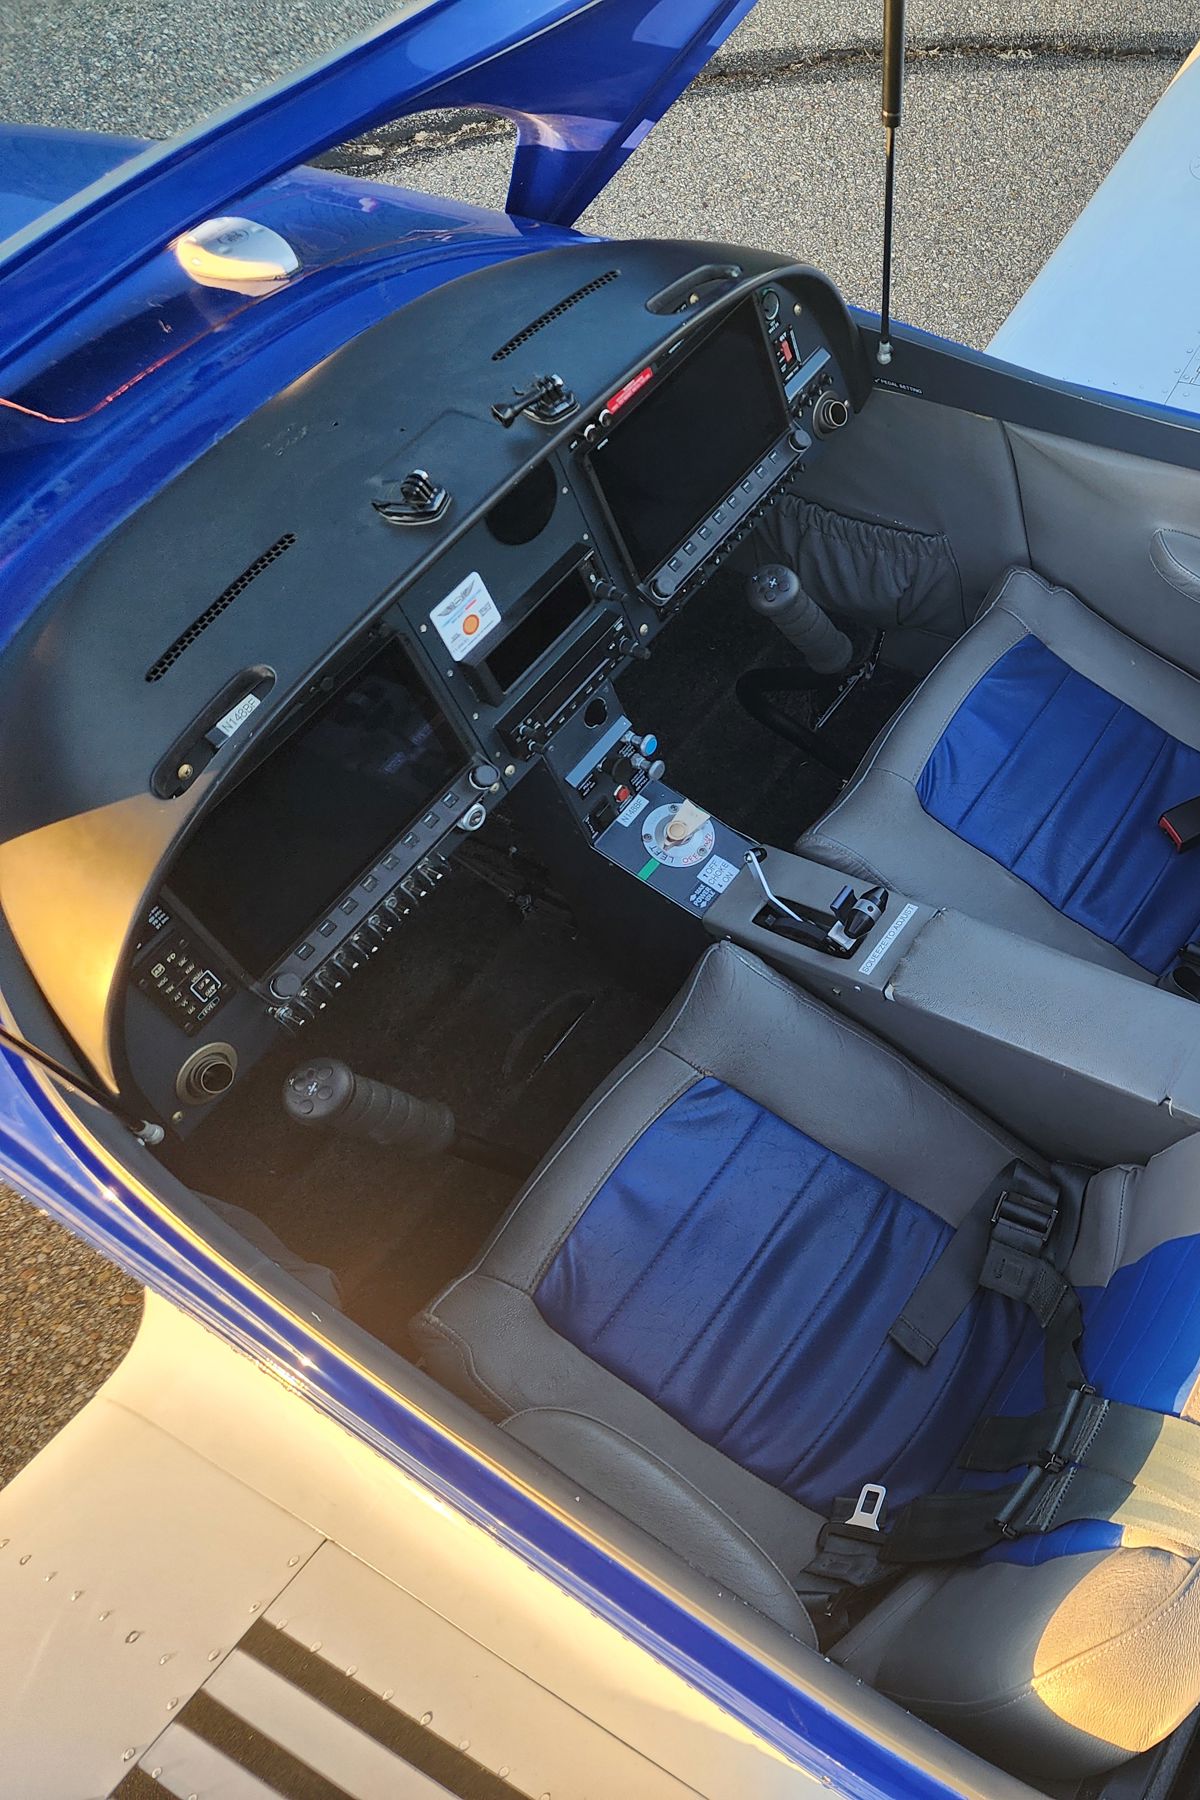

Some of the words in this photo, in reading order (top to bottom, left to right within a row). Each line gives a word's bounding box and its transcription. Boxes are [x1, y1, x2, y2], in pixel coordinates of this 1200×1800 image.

[880, 378, 899, 388] PEDAL
[222, 698, 257, 733] N148BF
[649, 845, 675, 864] LEFT
[705, 860, 718, 874] OFF
[707, 862, 729, 886] CHOKE
[723, 871, 734, 883] ON
[693, 886, 712, 907] POWER
[862, 939, 888, 973] SQUEEZE
[886, 930, 896, 941] TO
[894, 905, 914, 932] ADJUST
